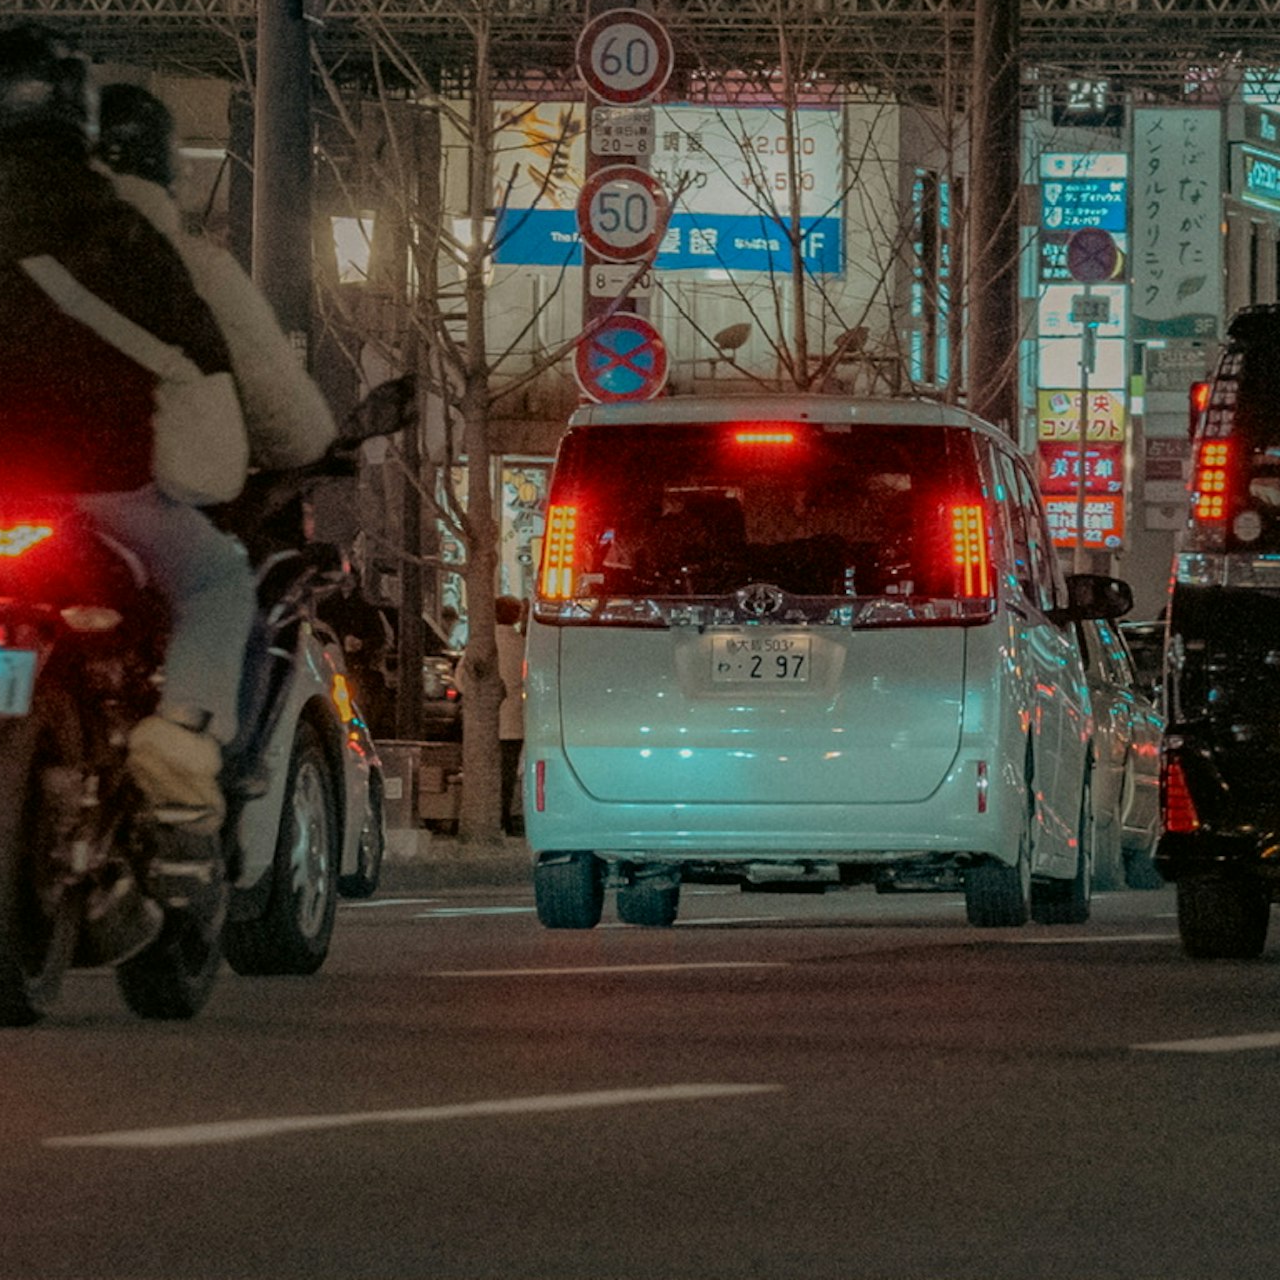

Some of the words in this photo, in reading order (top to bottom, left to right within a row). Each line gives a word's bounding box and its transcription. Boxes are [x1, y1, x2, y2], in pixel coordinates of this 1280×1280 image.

[600, 36, 649, 76] 60
[600, 138, 648, 152] 20-8
[742, 136, 816, 156] ¥2,00
[742, 172, 816, 192] ¥,50
[598, 192, 649, 233] 50
[1145, 116, 1167, 306] メンタルクリニック
[1178, 176, 1208, 266] ながた
[764, 639, 790, 652] 503
